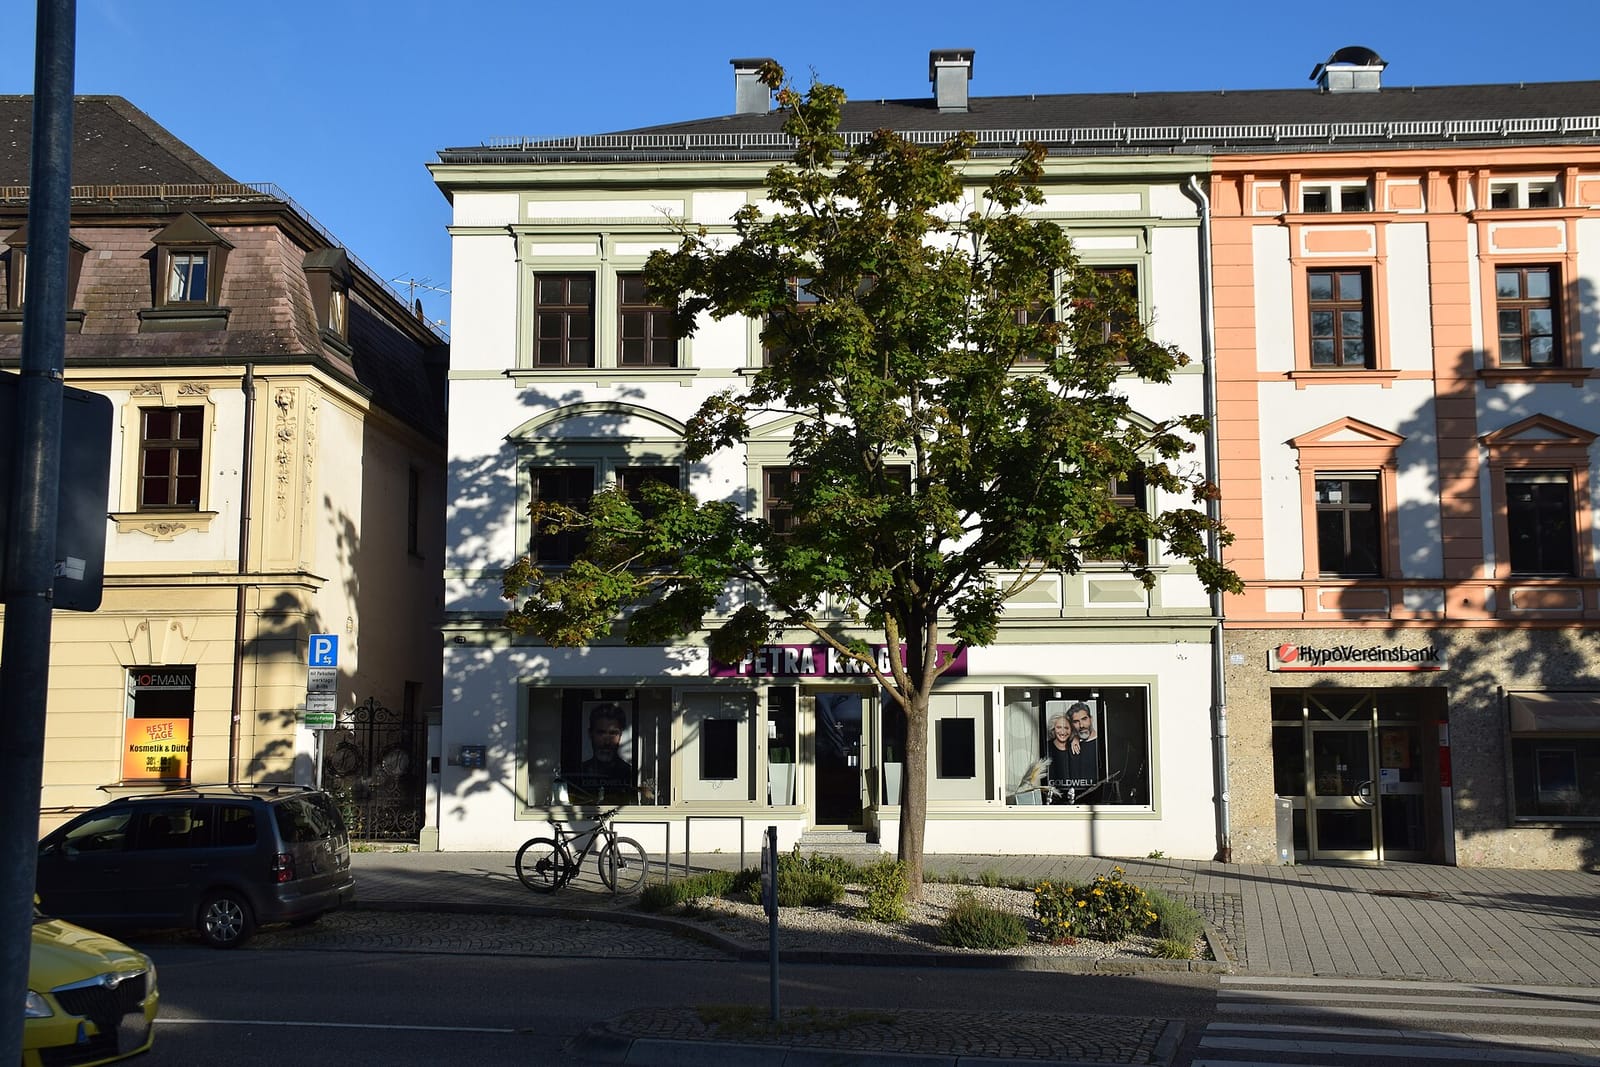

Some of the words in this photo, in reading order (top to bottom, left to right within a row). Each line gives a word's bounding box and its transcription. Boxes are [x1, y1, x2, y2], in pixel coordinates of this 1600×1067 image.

[739, 647, 816, 674] PETRA
[1300, 645, 1440, 666] HypoVereinsbank
[134, 673, 192, 686] HOFMANN
[146, 722, 174, 734] RESTE
[149, 731, 173, 740] TAGE
[129, 744, 163, 752] Kosmetik
